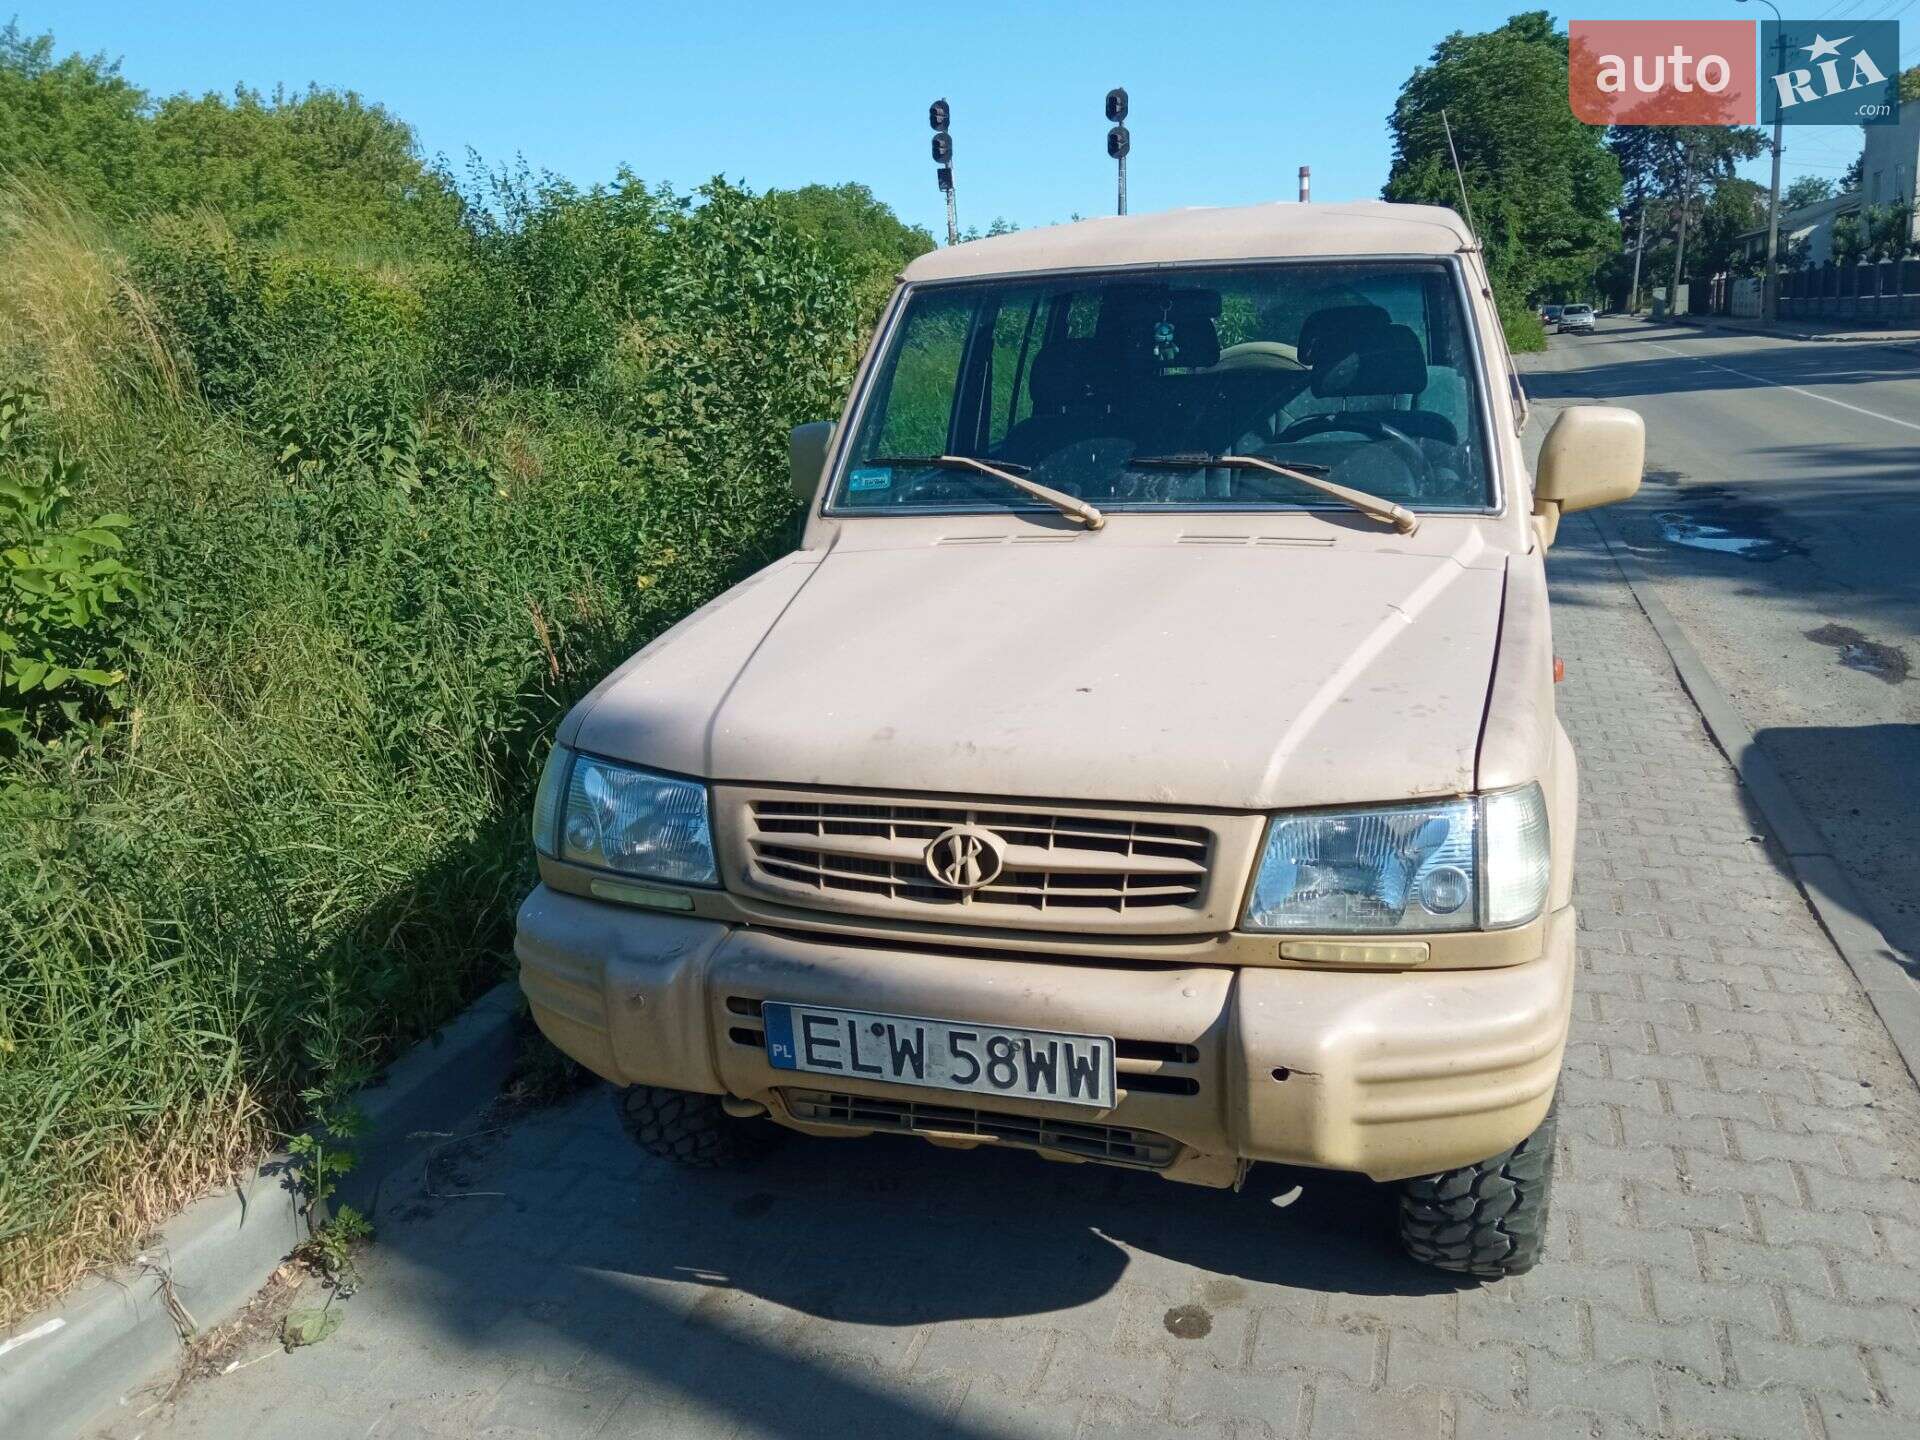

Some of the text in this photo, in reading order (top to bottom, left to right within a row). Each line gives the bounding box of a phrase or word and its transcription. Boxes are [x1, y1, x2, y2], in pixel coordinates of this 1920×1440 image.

[772, 1044, 792, 1058] PL
[801, 1014, 1101, 1100] ELW 58WW
